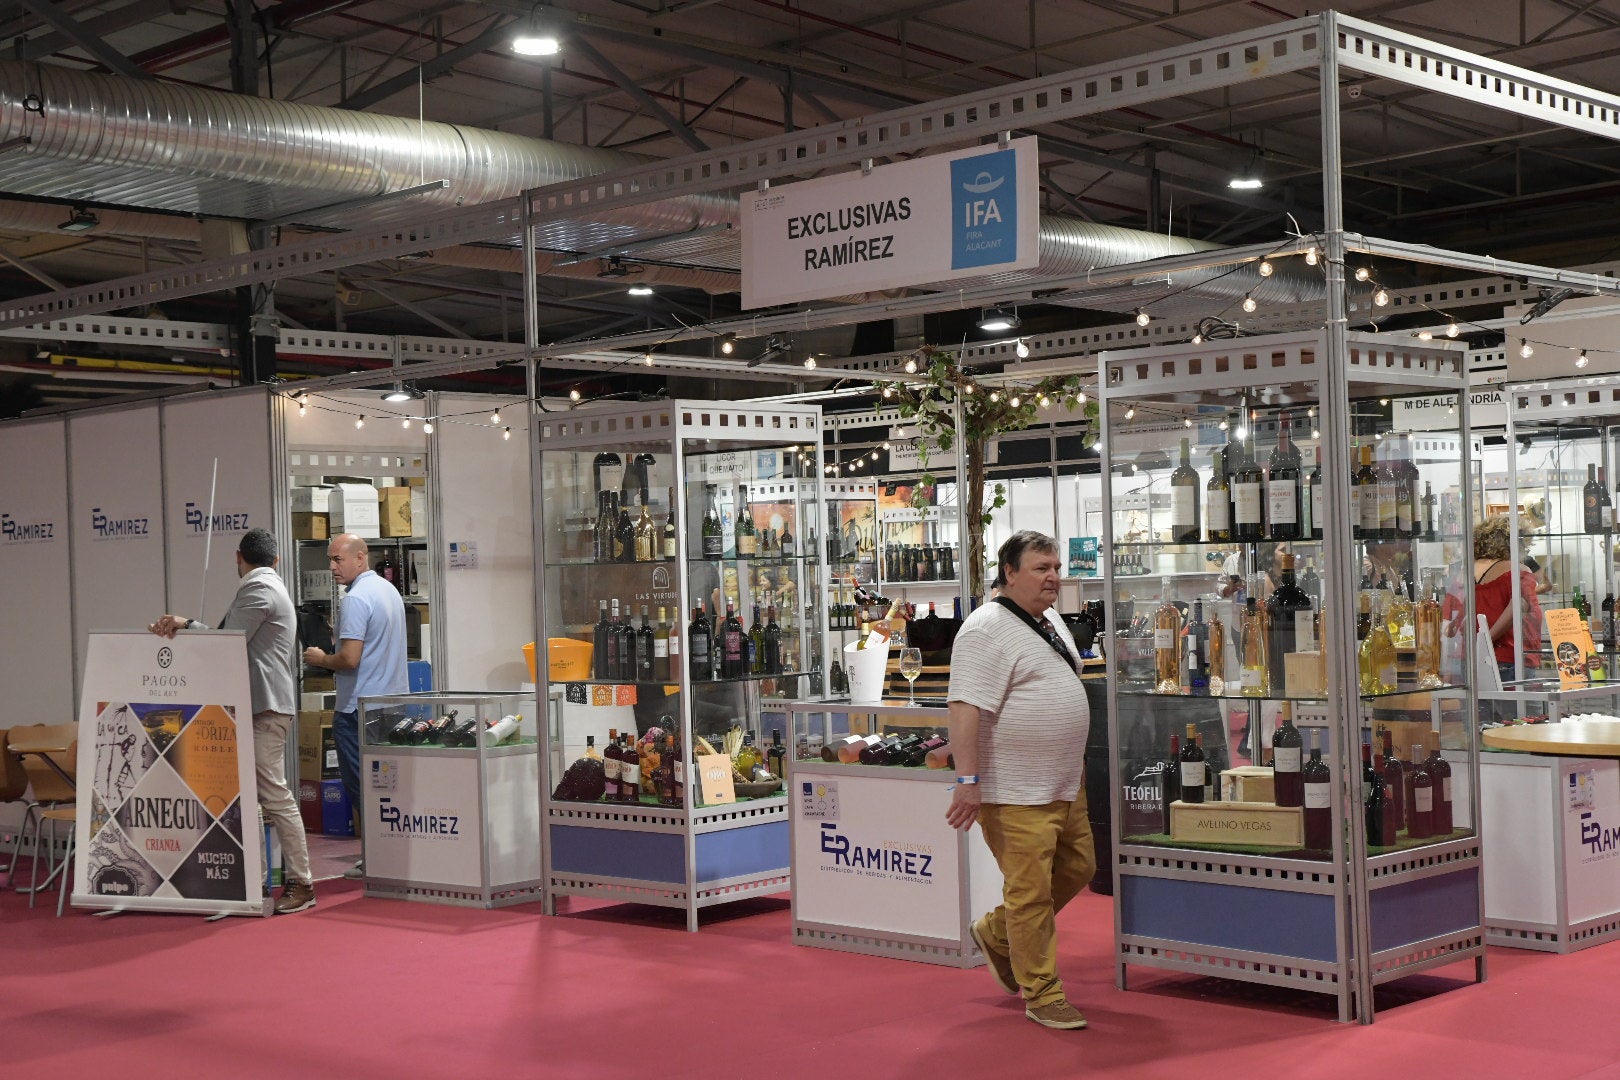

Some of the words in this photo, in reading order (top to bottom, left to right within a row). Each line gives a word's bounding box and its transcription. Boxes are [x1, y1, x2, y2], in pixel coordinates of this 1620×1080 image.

[788, 197, 911, 239] EXCLUSIVAS
[965, 199, 1002, 228] IFA
[966, 230, 983, 240] FIRA
[965, 238, 1002, 252] ALACANT
[805, 235, 894, 271] RAMÍREZ
[1415, 398, 1430, 409] DE
[1432, 392, 1502, 408] ALEJNDRÍA
[142, 675, 188, 687] PAGOS
[1122, 785, 1162, 801] TEÓFIL
[1197, 820, 1238, 830] AVELINO
[1240, 821, 1272, 831] VEGAS
[145, 838, 182, 852] CRIANZA
[197, 853, 235, 865] MUCHO
[206, 867, 230, 880] MÁS
[101, 881, 129, 894] pulpo
